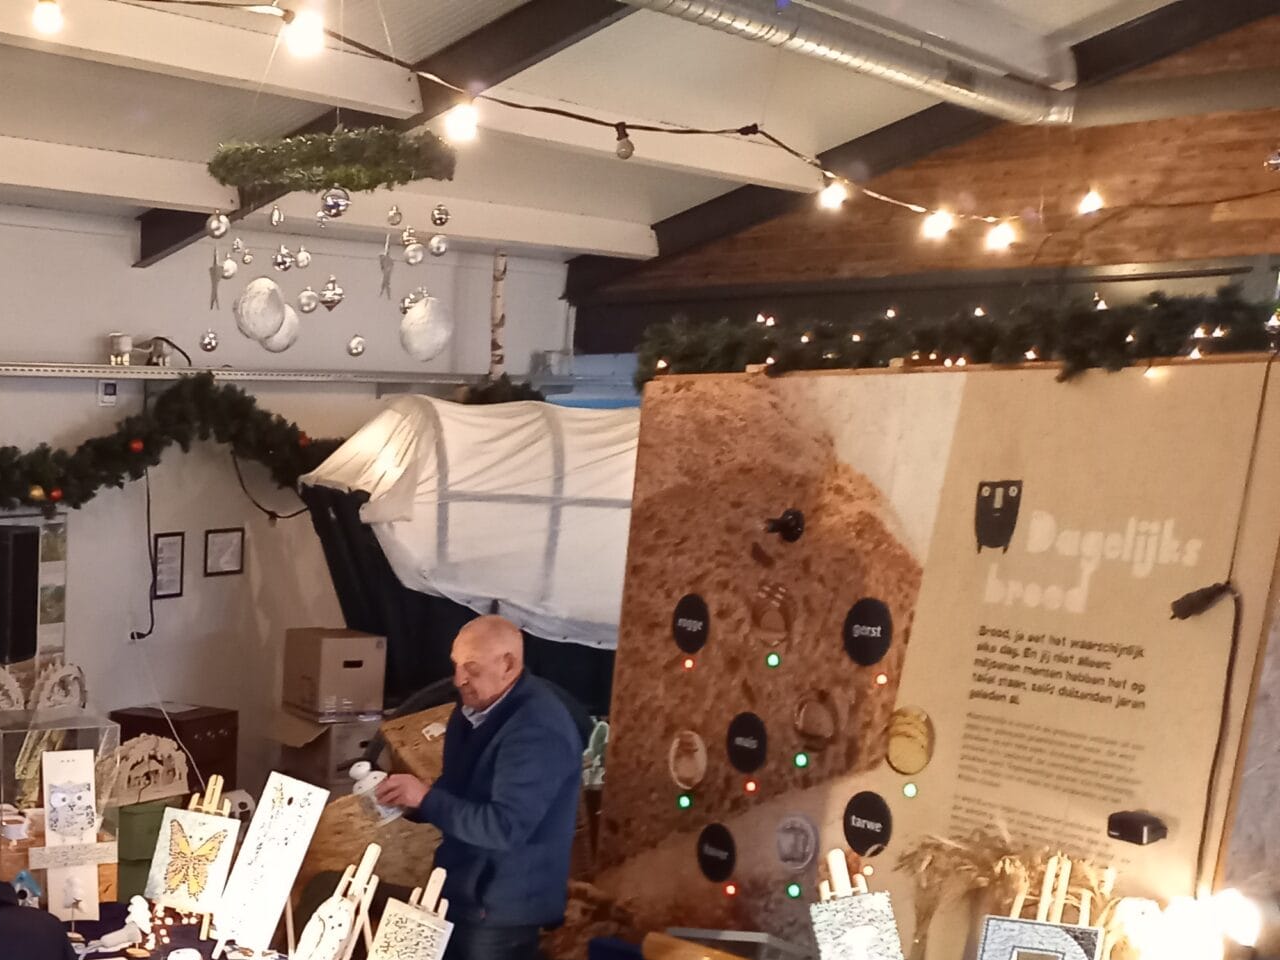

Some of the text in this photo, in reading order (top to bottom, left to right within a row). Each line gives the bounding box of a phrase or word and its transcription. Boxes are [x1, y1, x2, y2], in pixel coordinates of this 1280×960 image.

[1026, 510, 1202, 578] Dagelijks
[984, 562, 1090, 613] brood
[852, 624, 883, 638] gerst
[1131, 682, 1146, 695] op
[850, 814, 883, 833] tarwe
